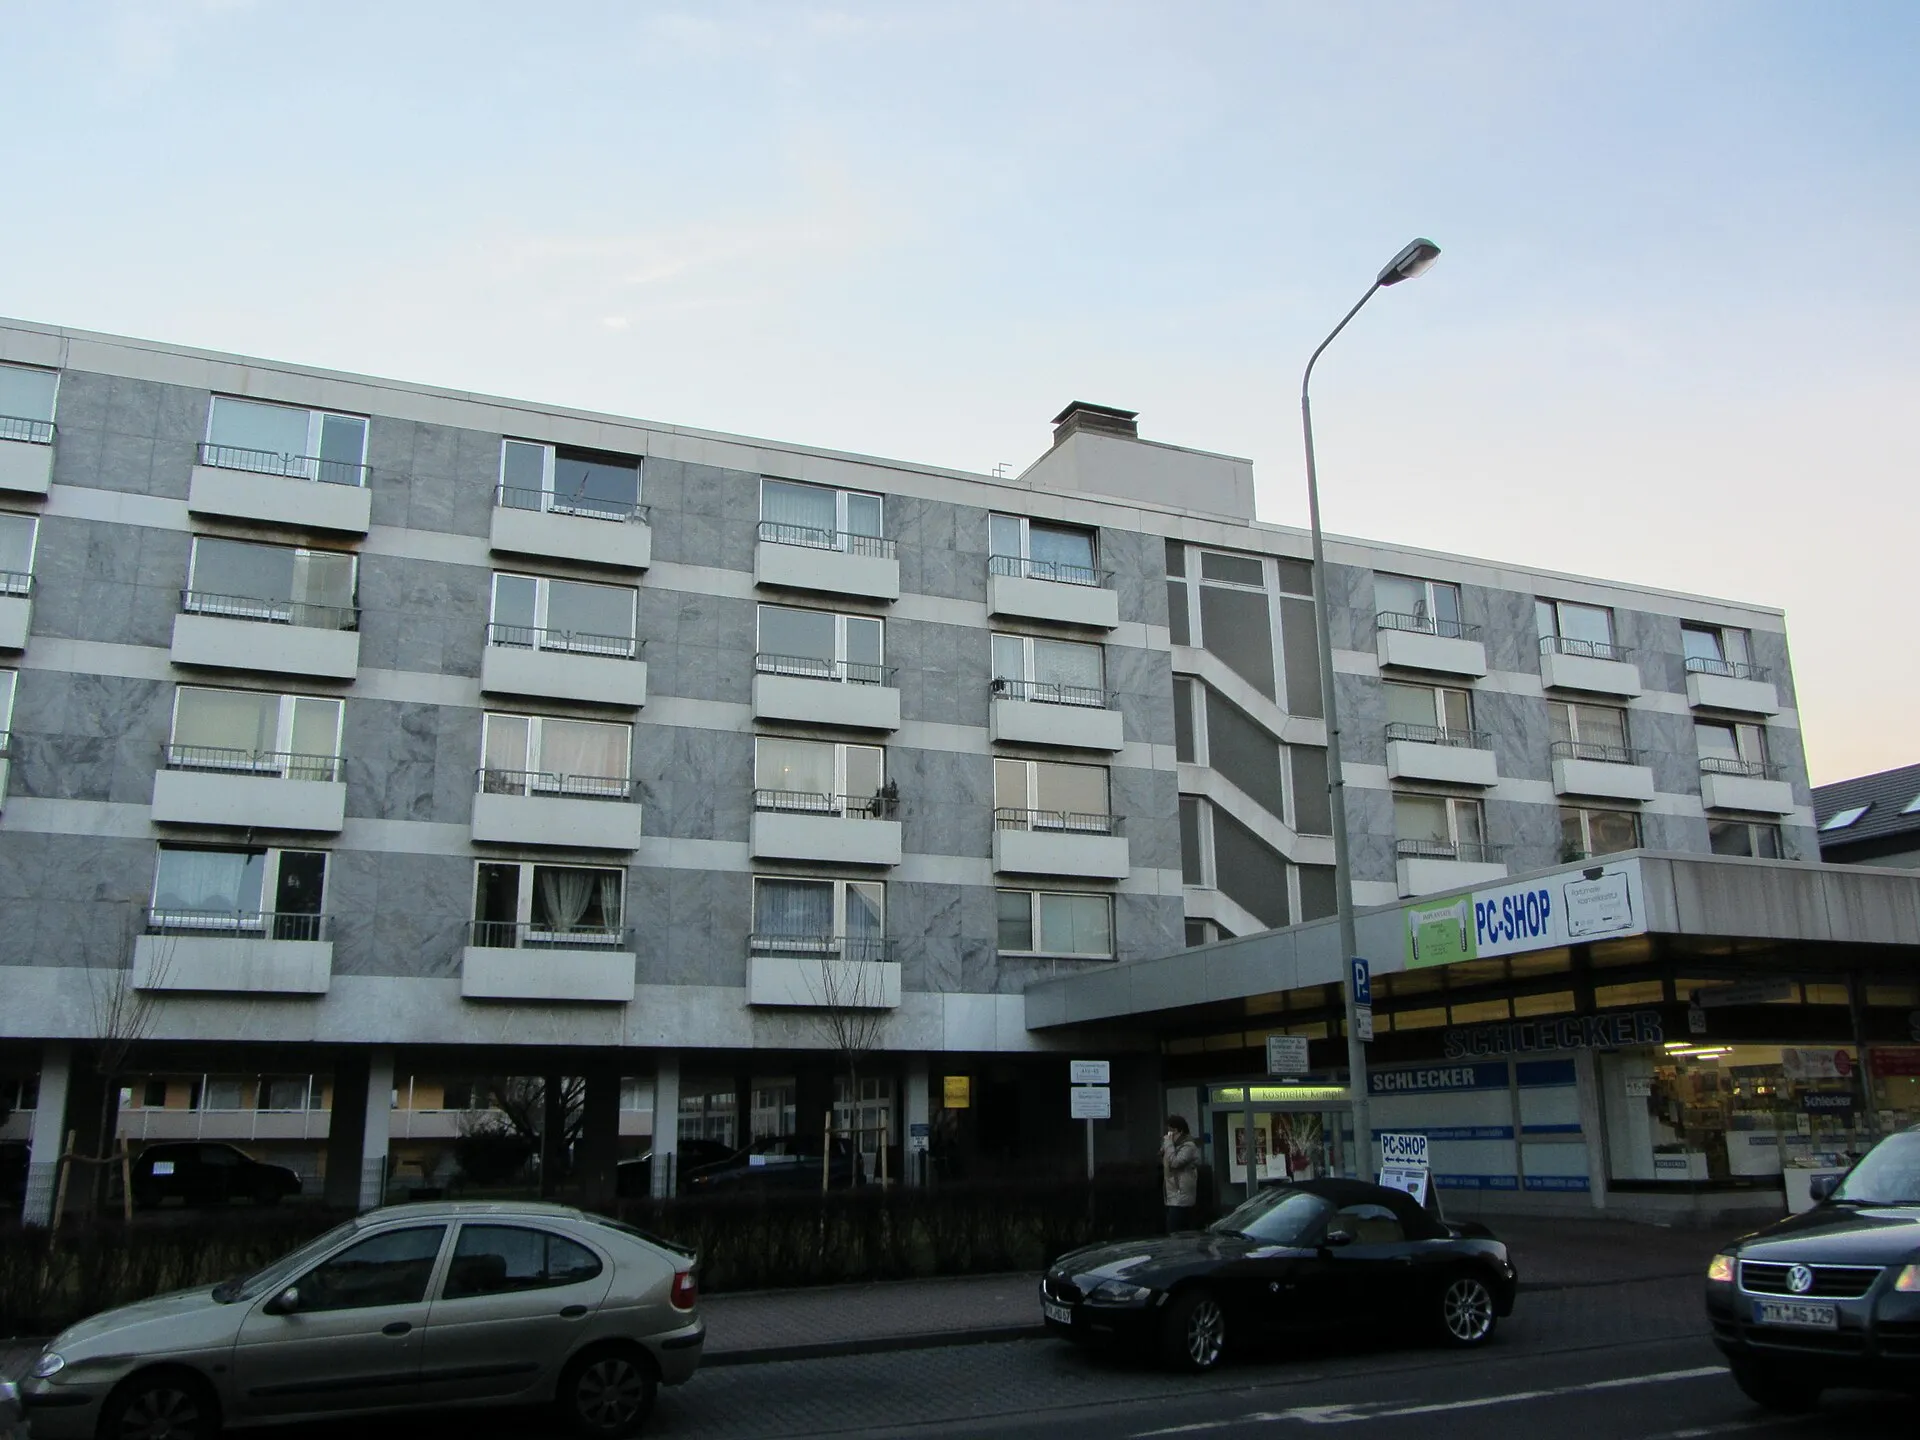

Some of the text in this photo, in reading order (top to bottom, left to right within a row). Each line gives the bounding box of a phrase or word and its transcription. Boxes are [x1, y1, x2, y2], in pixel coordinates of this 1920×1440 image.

[1475, 889, 1550, 945] PC-SHOP
[1355, 963, 1366, 998] P
[1443, 1010, 1664, 1060] SCHLECKER
[1373, 1067, 1475, 1091] SCHLECKER
[1382, 1135, 1426, 1155] PC-SHOP
